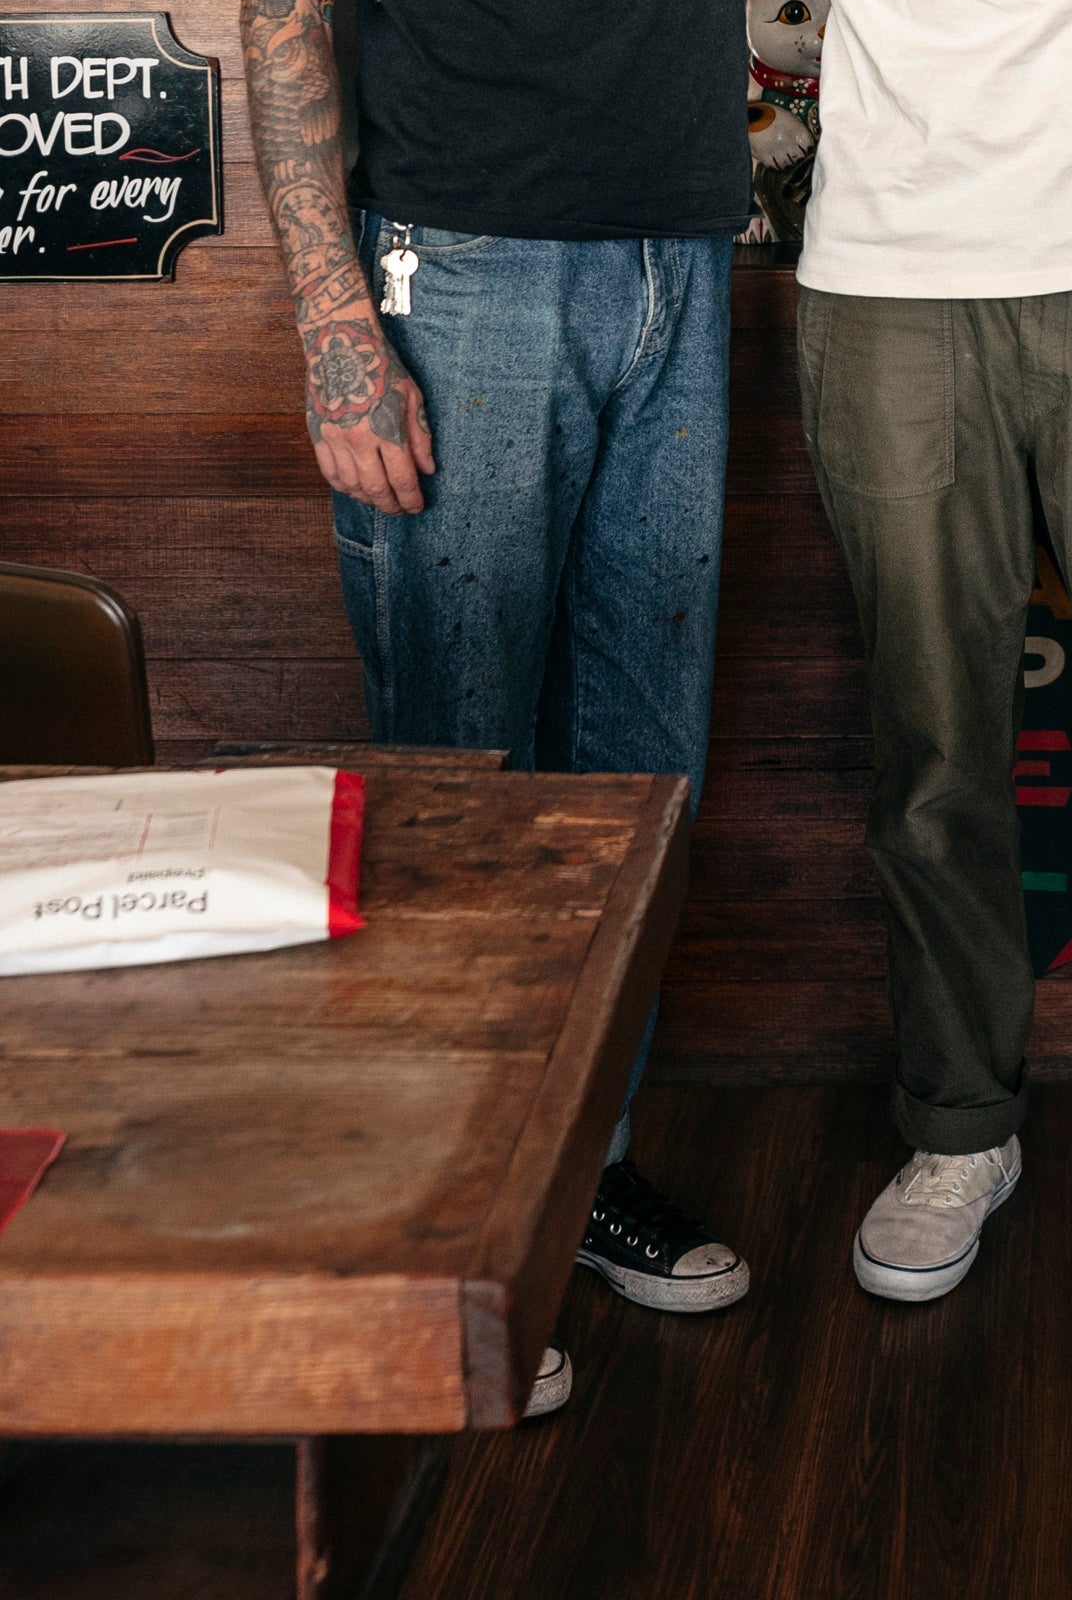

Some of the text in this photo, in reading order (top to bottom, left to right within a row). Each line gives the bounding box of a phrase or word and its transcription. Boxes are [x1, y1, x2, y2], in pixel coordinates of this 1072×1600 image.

[0, 55, 167, 101] H DEPT.
[16, 170, 183, 223] for every
[33, 889, 208, 921] Parcel Post
